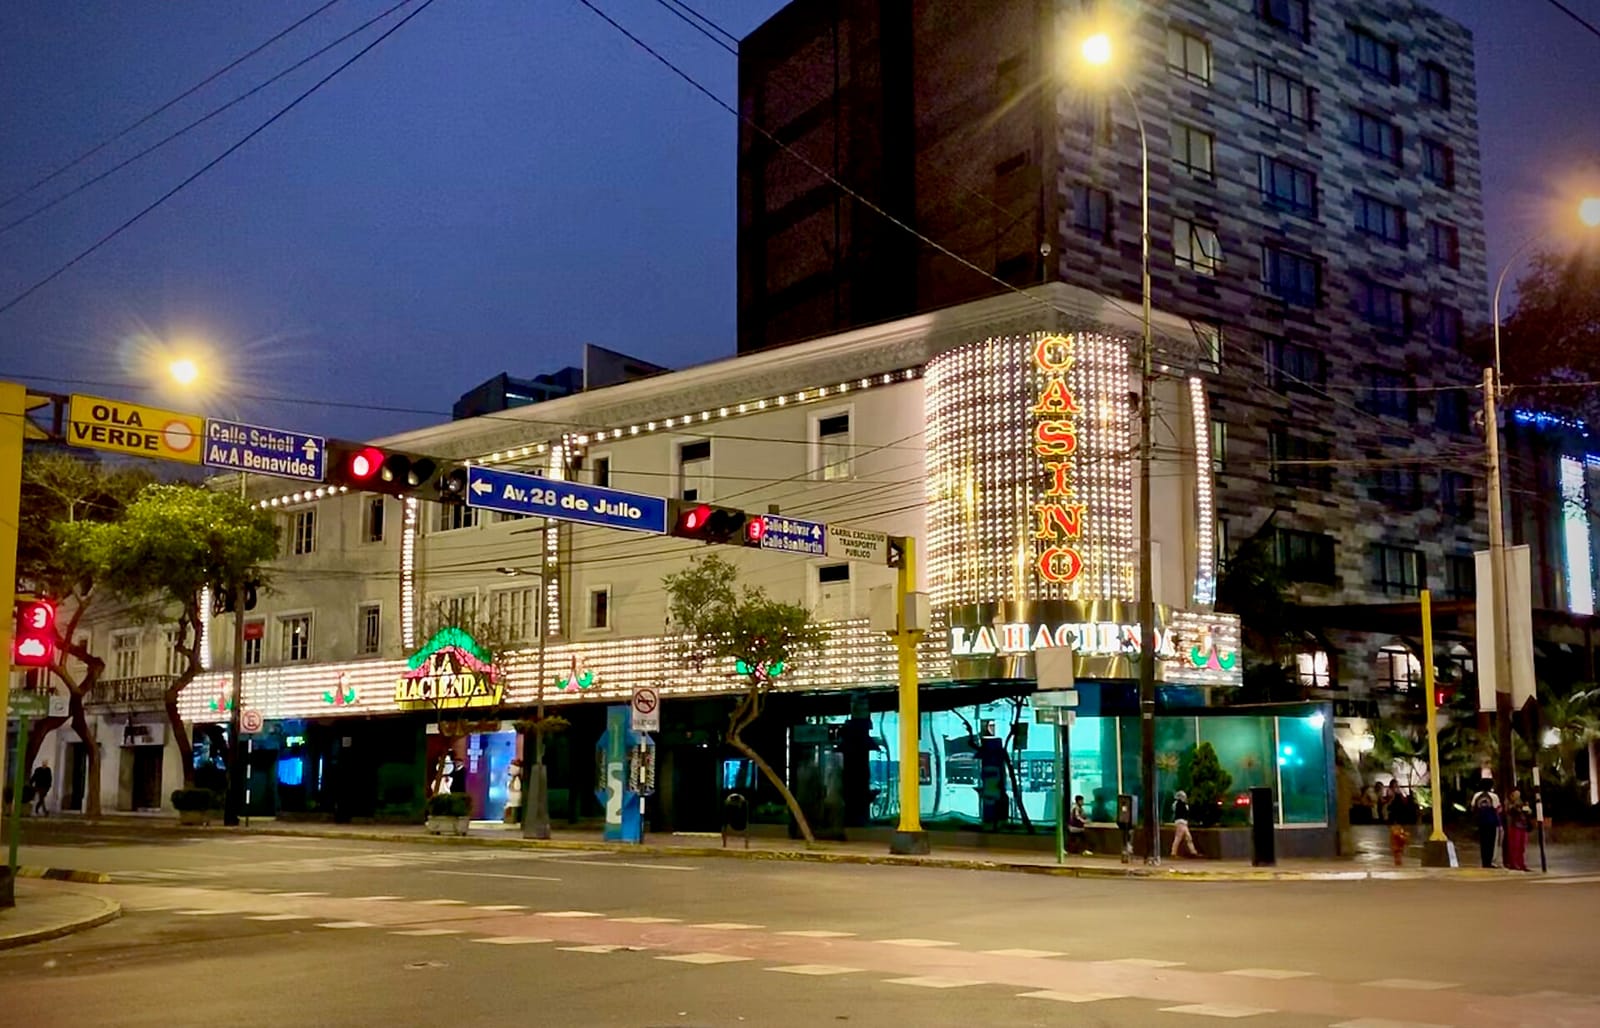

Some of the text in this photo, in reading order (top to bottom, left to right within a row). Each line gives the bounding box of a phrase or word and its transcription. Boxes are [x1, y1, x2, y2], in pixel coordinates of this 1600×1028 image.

[92, 405, 143, 427] OLA
[73, 422, 159, 450] VERDE
[210, 423, 295, 453] Calle Schell
[242, 450, 316, 477] Benavides
[1033, 335, 1086, 583] CASINO
[503, 484, 642, 519] Av. 28 de Julio
[763, 517, 783, 532] Calle
[830, 527, 885, 542] CARRIL EXCLUSIVO
[763, 533, 783, 548] Calle
[783, 536, 798, 551] San
[839, 538, 877, 551] TRANSPORTE
[951, 624, 997, 654] LA
[429, 653, 454, 676] LA
[395, 673, 488, 700] HACIENDA
